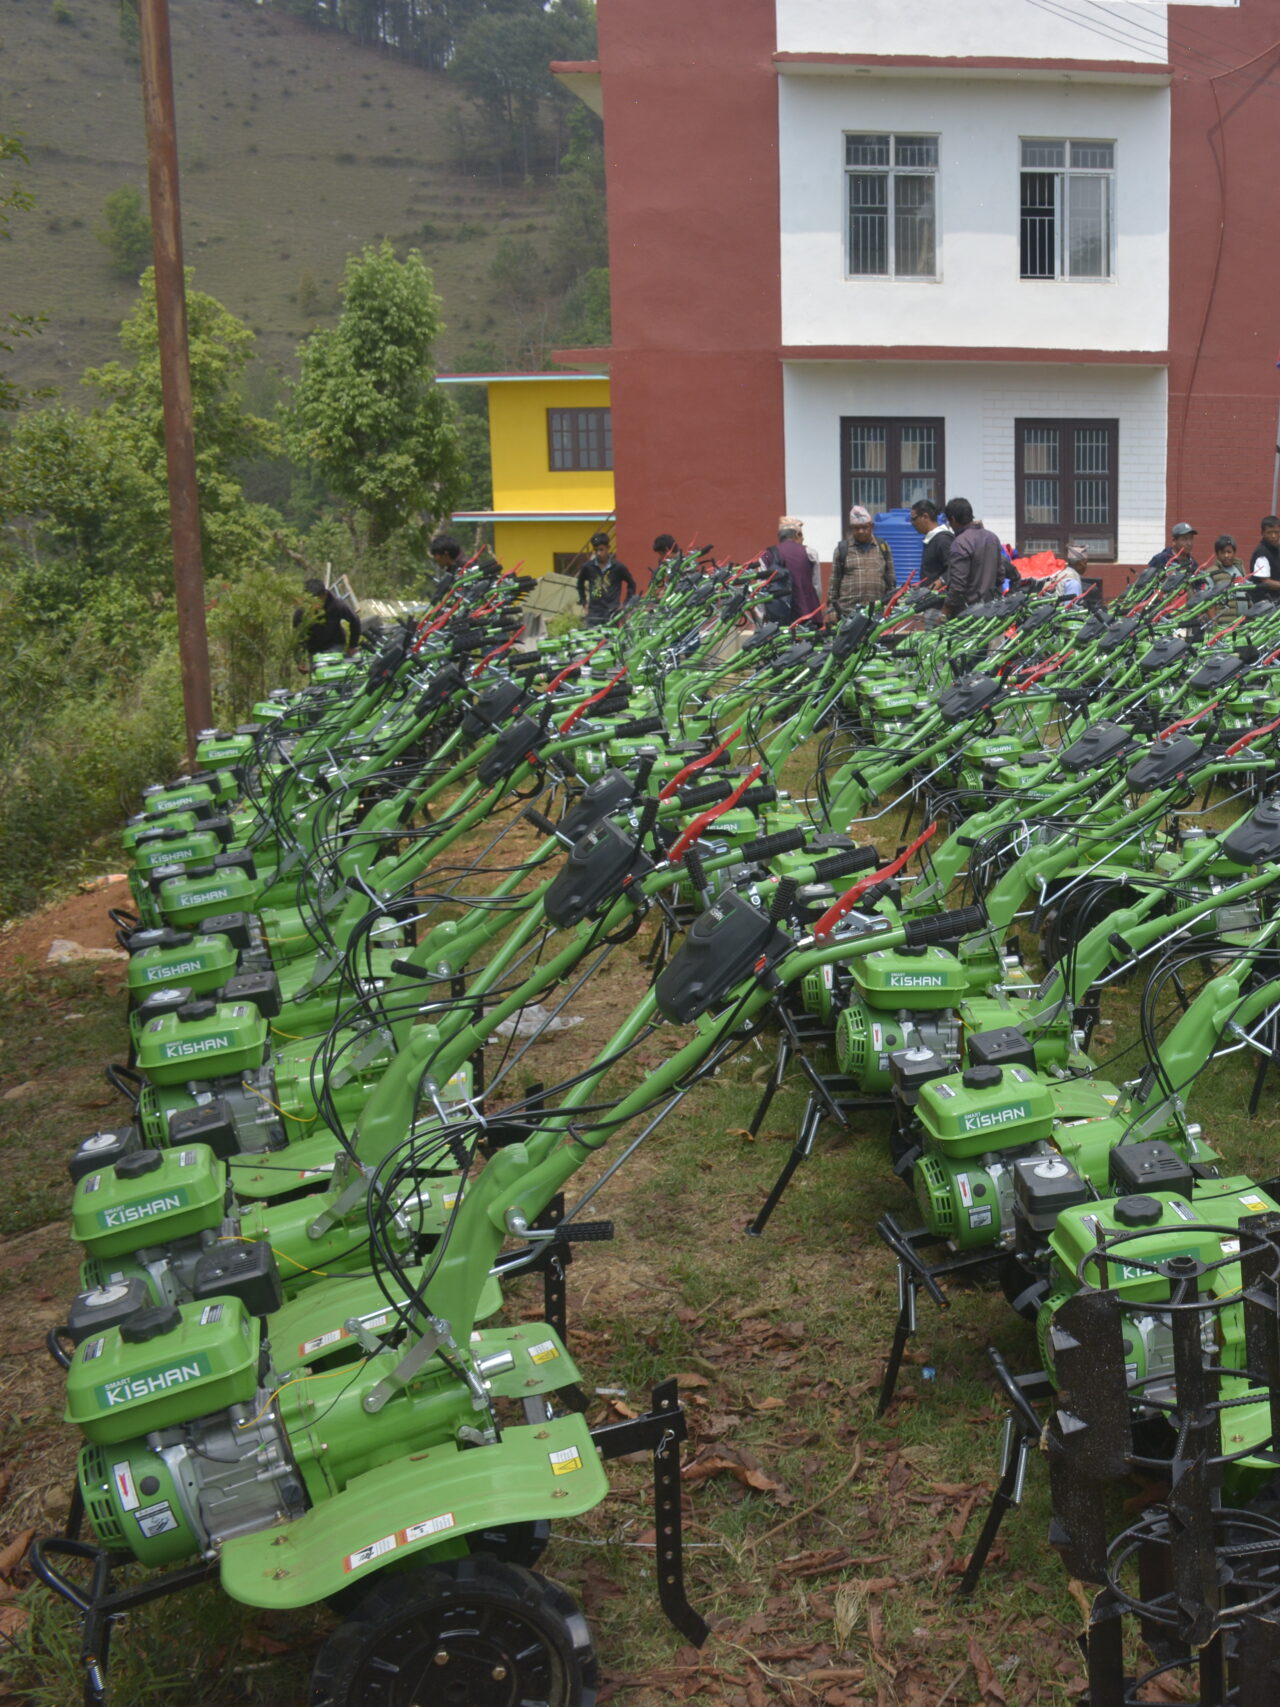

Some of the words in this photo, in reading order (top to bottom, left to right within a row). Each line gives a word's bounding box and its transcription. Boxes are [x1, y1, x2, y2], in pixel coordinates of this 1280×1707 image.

[156, 797, 193, 811] KISHAN
[150, 849, 193, 864] KISHAN
[180, 889, 228, 906] KISHAN
[147, 960, 201, 981] KISHAN
[890, 976, 942, 987] KISHAN
[166, 1036, 229, 1059] KISHAN
[964, 1106, 1026, 1131] KISHAN
[105, 1194, 181, 1228] KISHAN
[104, 1377, 131, 1391] SMART
[106, 1362, 201, 1406] KISHAN
